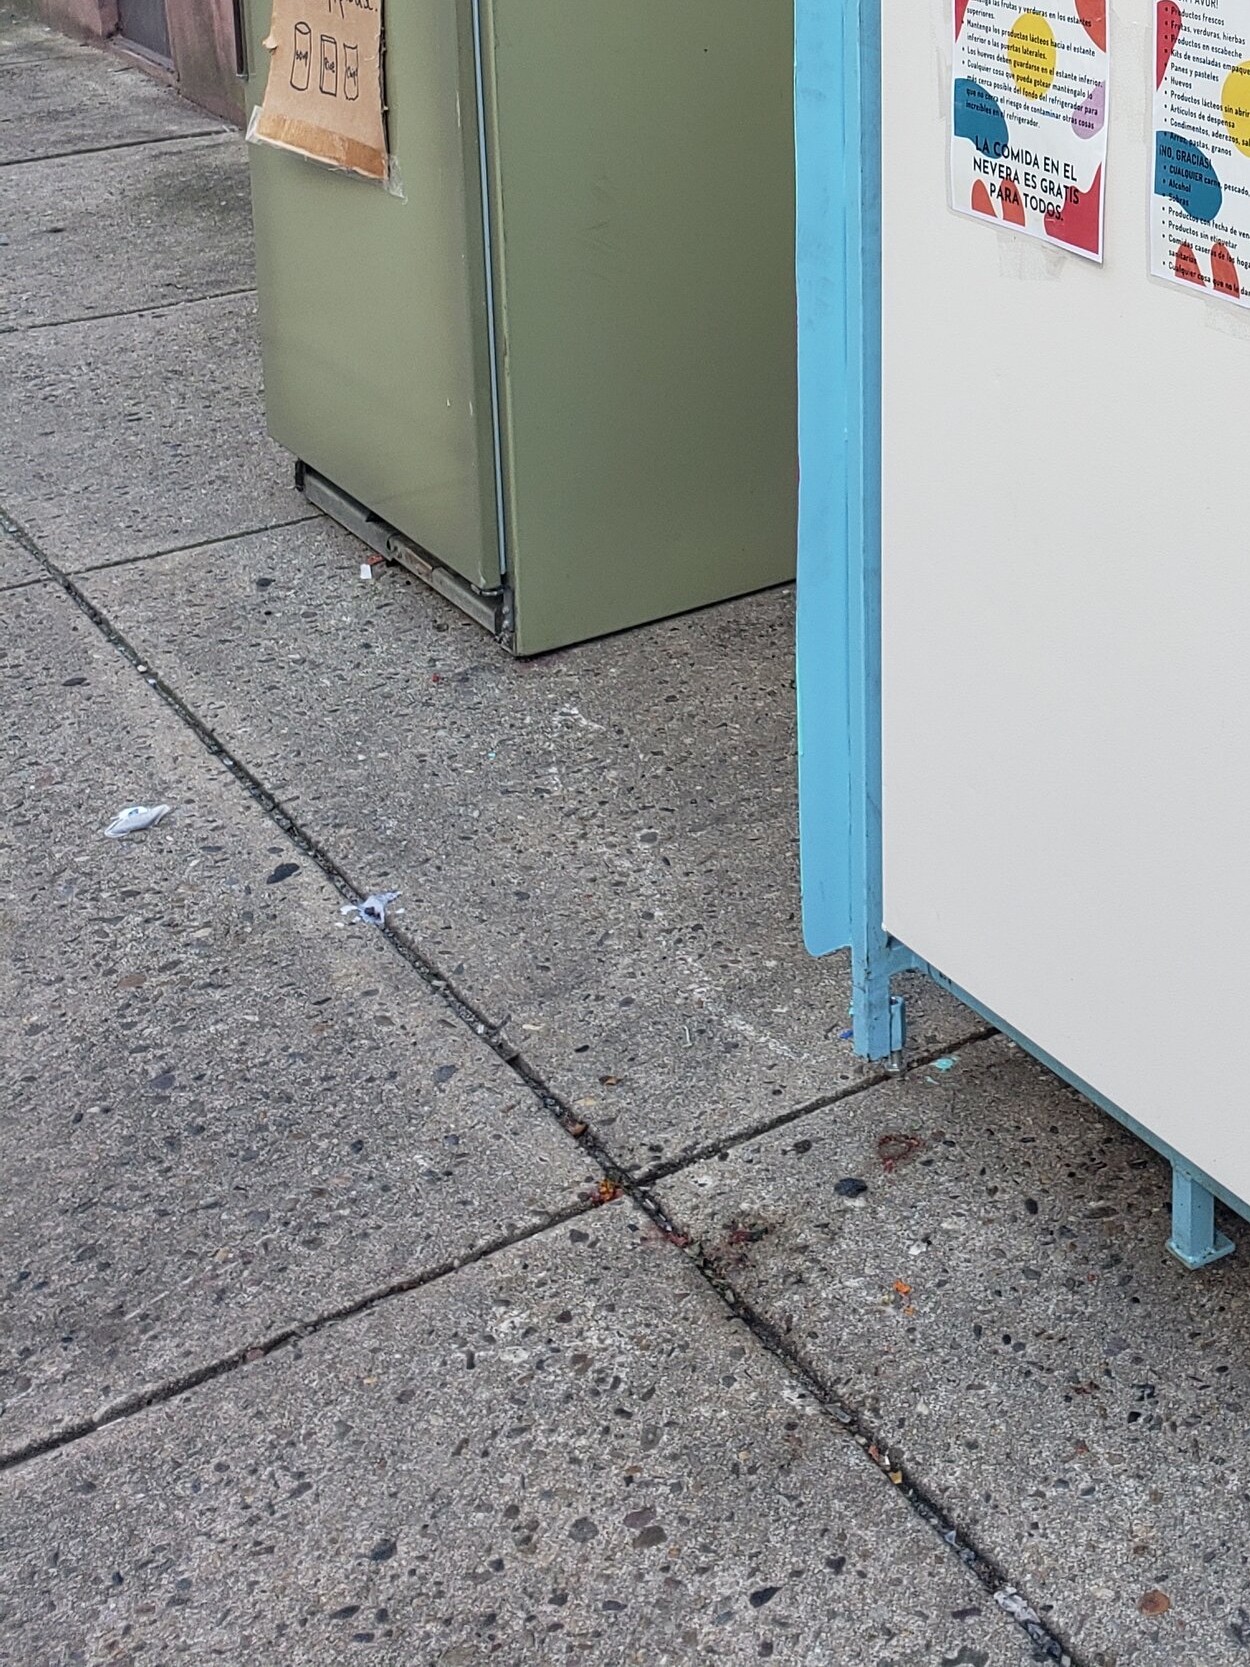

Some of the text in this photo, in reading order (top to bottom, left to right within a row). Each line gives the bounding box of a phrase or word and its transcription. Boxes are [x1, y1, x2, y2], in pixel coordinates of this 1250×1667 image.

[1171, 7, 1225, 26] Productos frescos
[1171, 35, 1243, 58] Productos en escabeche
[1223, 33, 1245, 45] hierbas
[977, 50, 995, 60] huevos
[997, 54, 1012, 64] deben
[1074, 46, 1095, 57] estante
[1184, 52, 1191, 60] de
[1193, 55, 1221, 68] ensaladas
[1171, 63, 1188, 74] Panes
[1195, 71, 1219, 82] pasteles
[1171, 77, 1192, 89] Huevos
[1171, 91, 1250, 118] Productos sin abrir
[1198, 111, 1235, 129] de despensa
[976, 136, 1077, 181] LA COMIDA EN EL
[1211, 144, 1232, 156] granos
[974, 157, 1079, 204] NEVERA ES GRATIS
[990, 183, 1064, 221] PARA TODOS.
[1169, 207, 1199, 222] Productos
[1212, 220, 1228, 232] fecha
[1230, 227, 1237, 236] de
[1169, 221, 1237, 250] Productos sin etiquetar
[1169, 235, 1193, 249] Comidas
